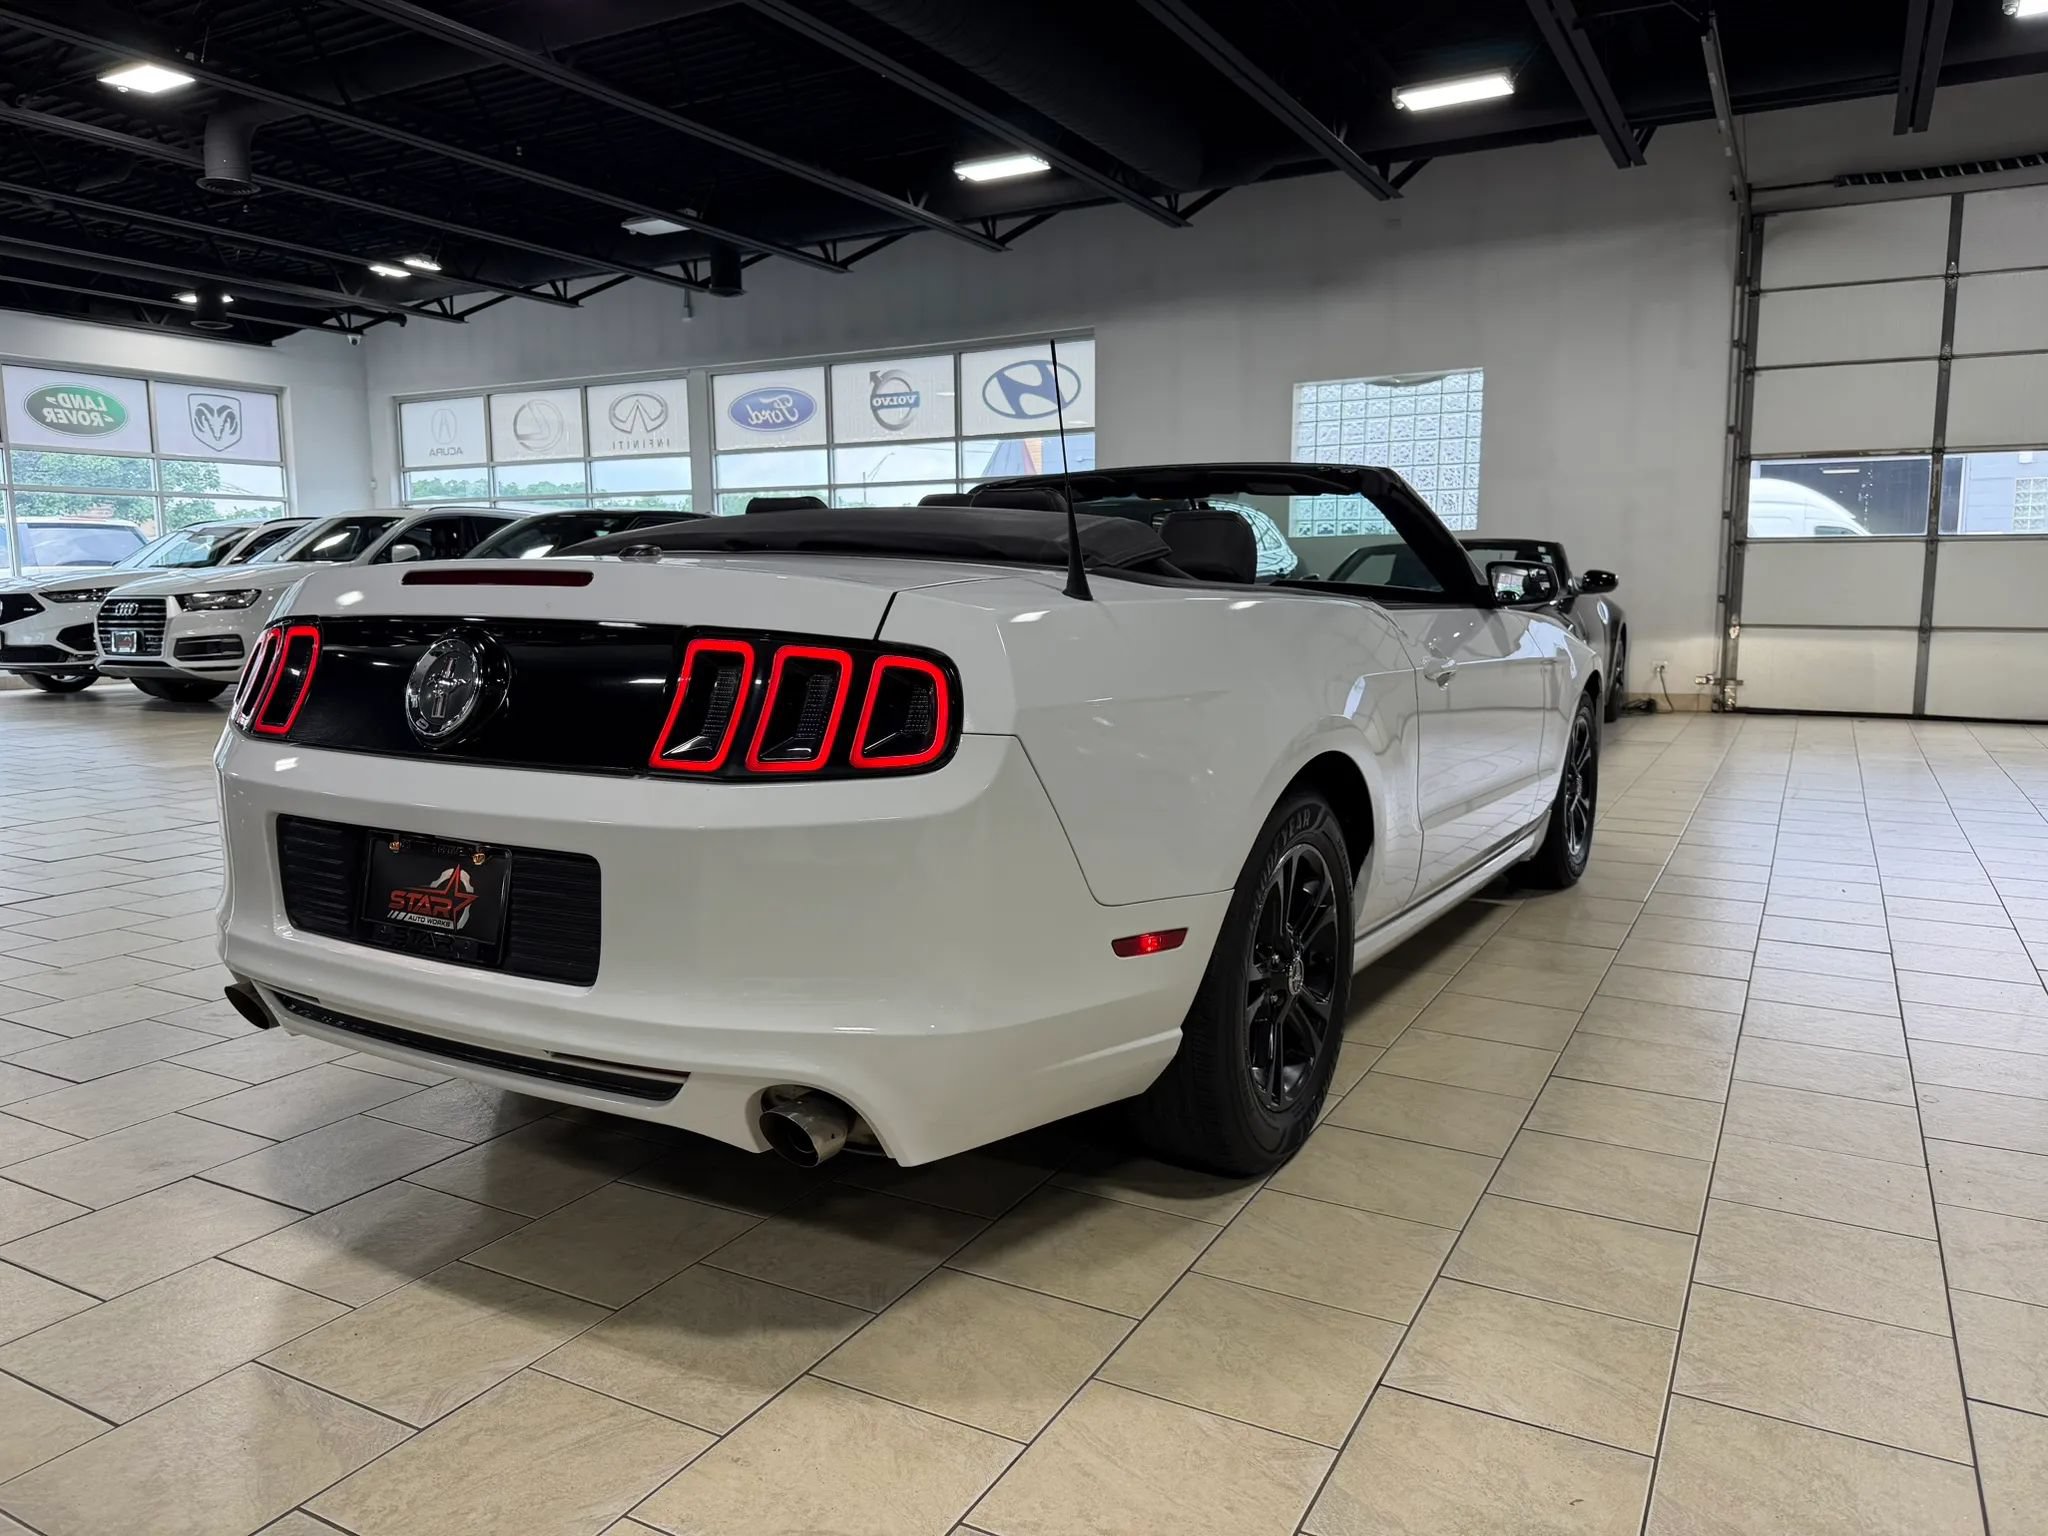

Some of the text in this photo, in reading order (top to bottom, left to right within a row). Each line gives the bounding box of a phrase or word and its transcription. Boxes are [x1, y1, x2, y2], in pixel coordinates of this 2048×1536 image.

[388, 889, 454, 919] STAR
[407, 914, 451, 928] AUTO WORKS
